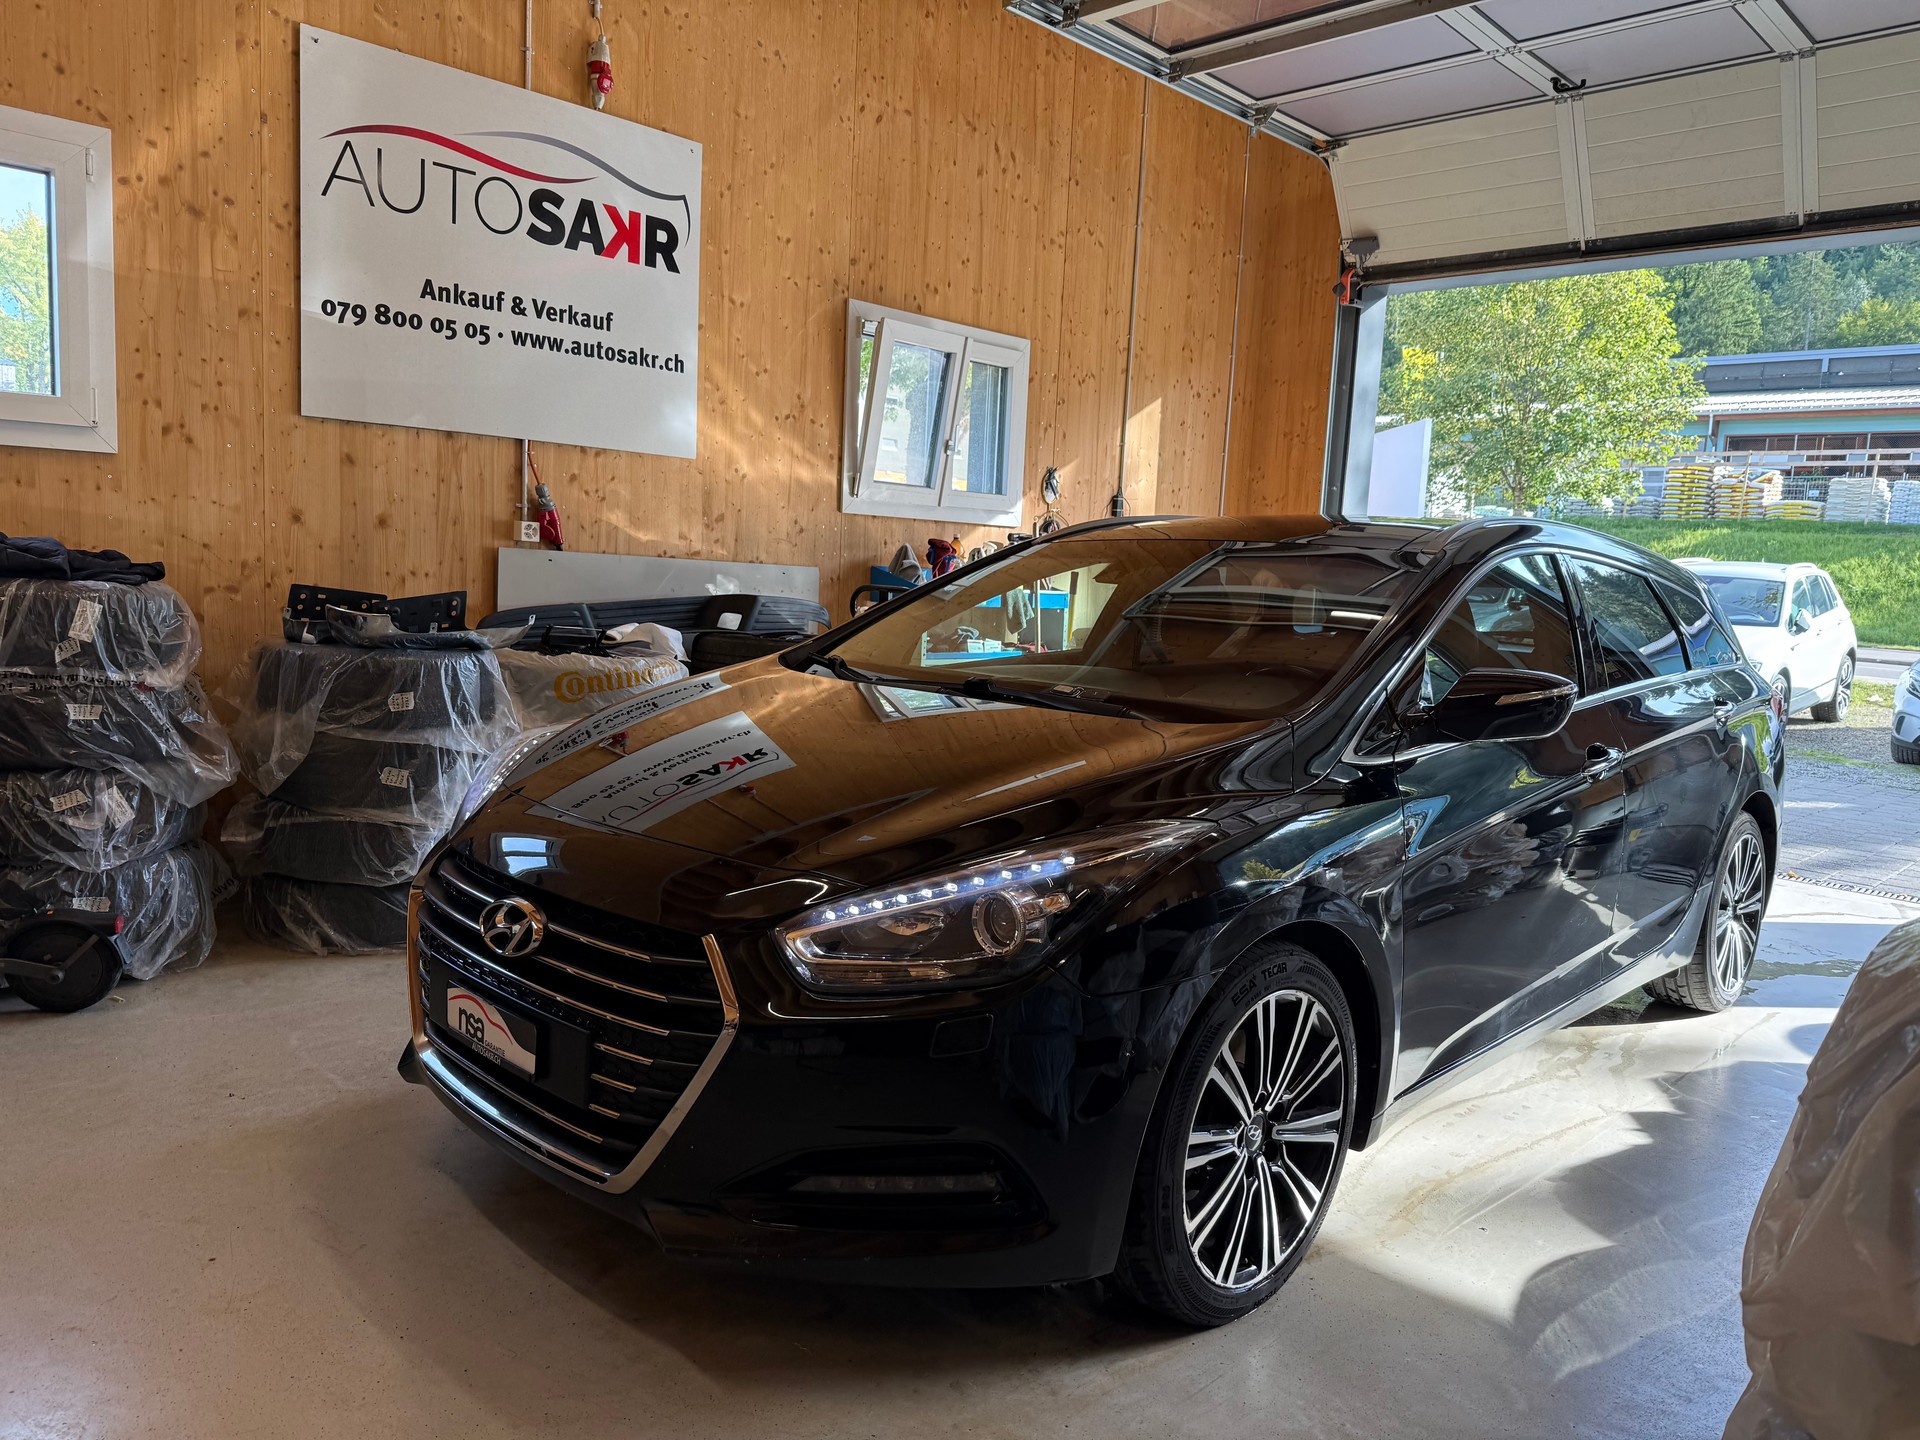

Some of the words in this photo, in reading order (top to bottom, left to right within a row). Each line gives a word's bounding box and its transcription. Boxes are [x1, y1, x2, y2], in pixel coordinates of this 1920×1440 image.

[320, 139, 681, 274] AUTOSAKR
[420, 278, 506, 313] Ankauf
[510, 294, 528, 317] &
[532, 297, 615, 332] Verkauf
[320, 298, 367, 327] 079
[374, 302, 423, 330] 800
[430, 316, 457, 341] 05
[464, 321, 491, 346] 05
[511, 328, 685, 374] www.autosakr.ch
[1261, 961, 1288, 980] TECAR
[458, 1006, 485, 1045] nsa
